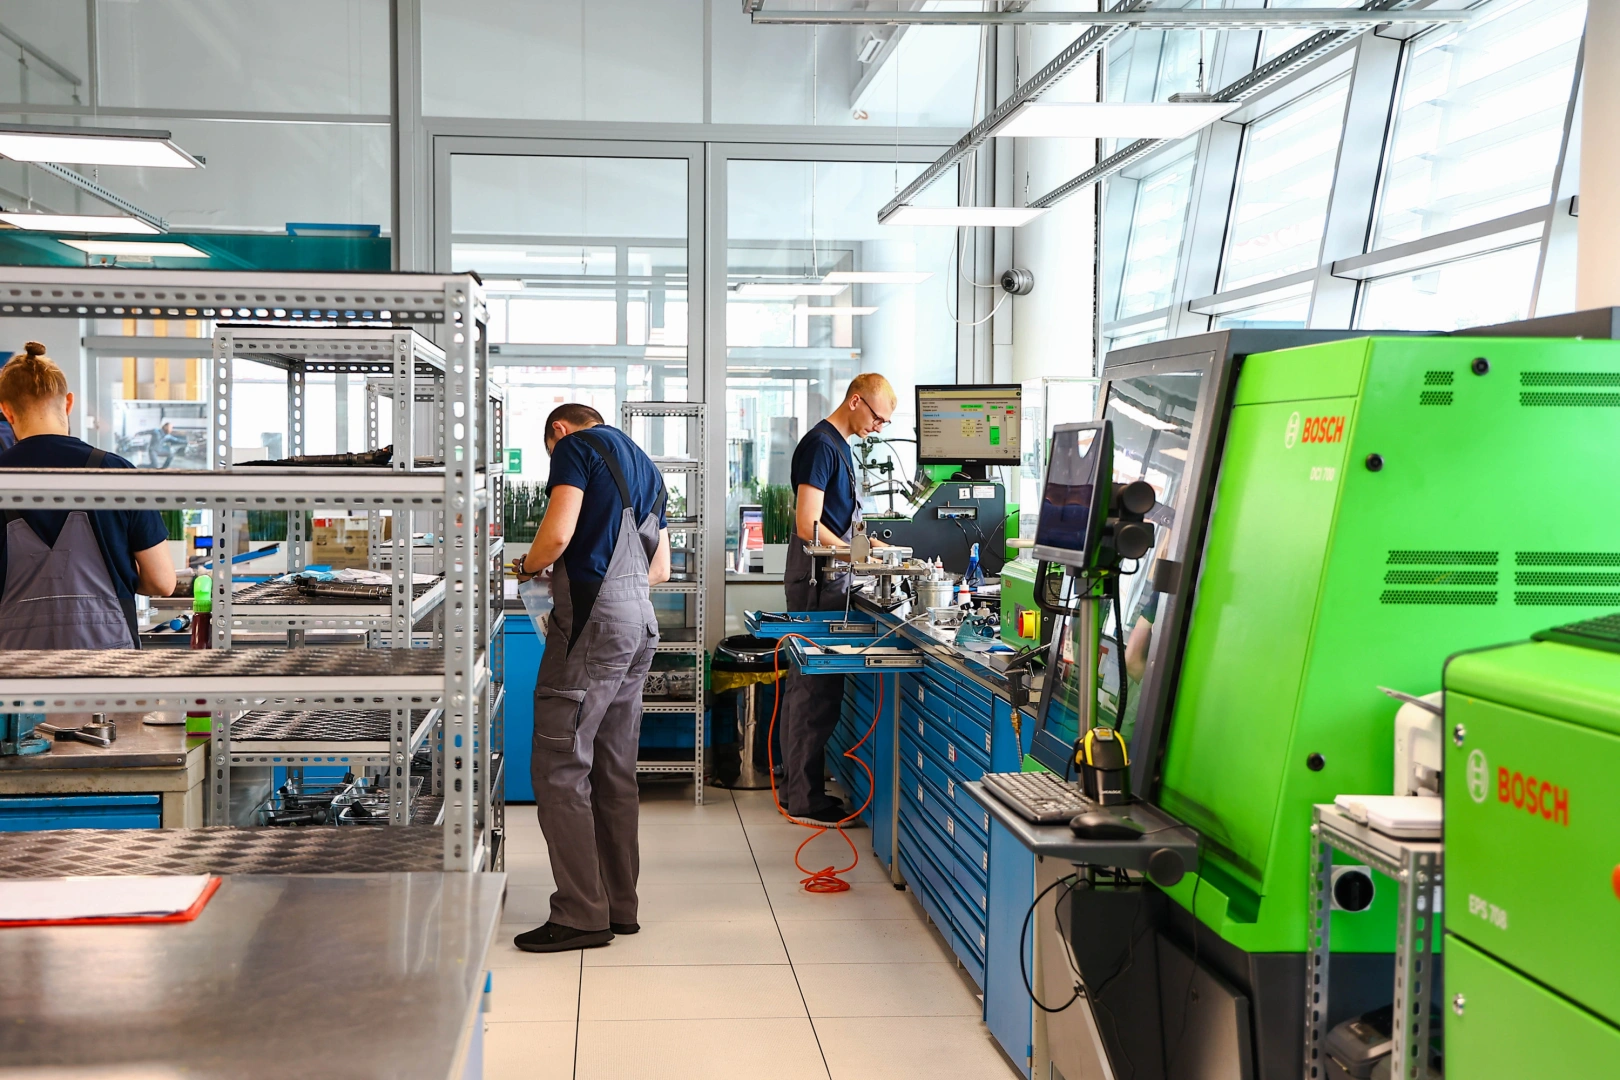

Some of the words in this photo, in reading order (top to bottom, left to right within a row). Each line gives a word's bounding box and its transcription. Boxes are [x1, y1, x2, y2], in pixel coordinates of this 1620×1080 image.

[1302, 416, 1346, 443] BOSCH
[1498, 766, 1569, 827] BOSCH
[1469, 894, 1488, 920] EPS
